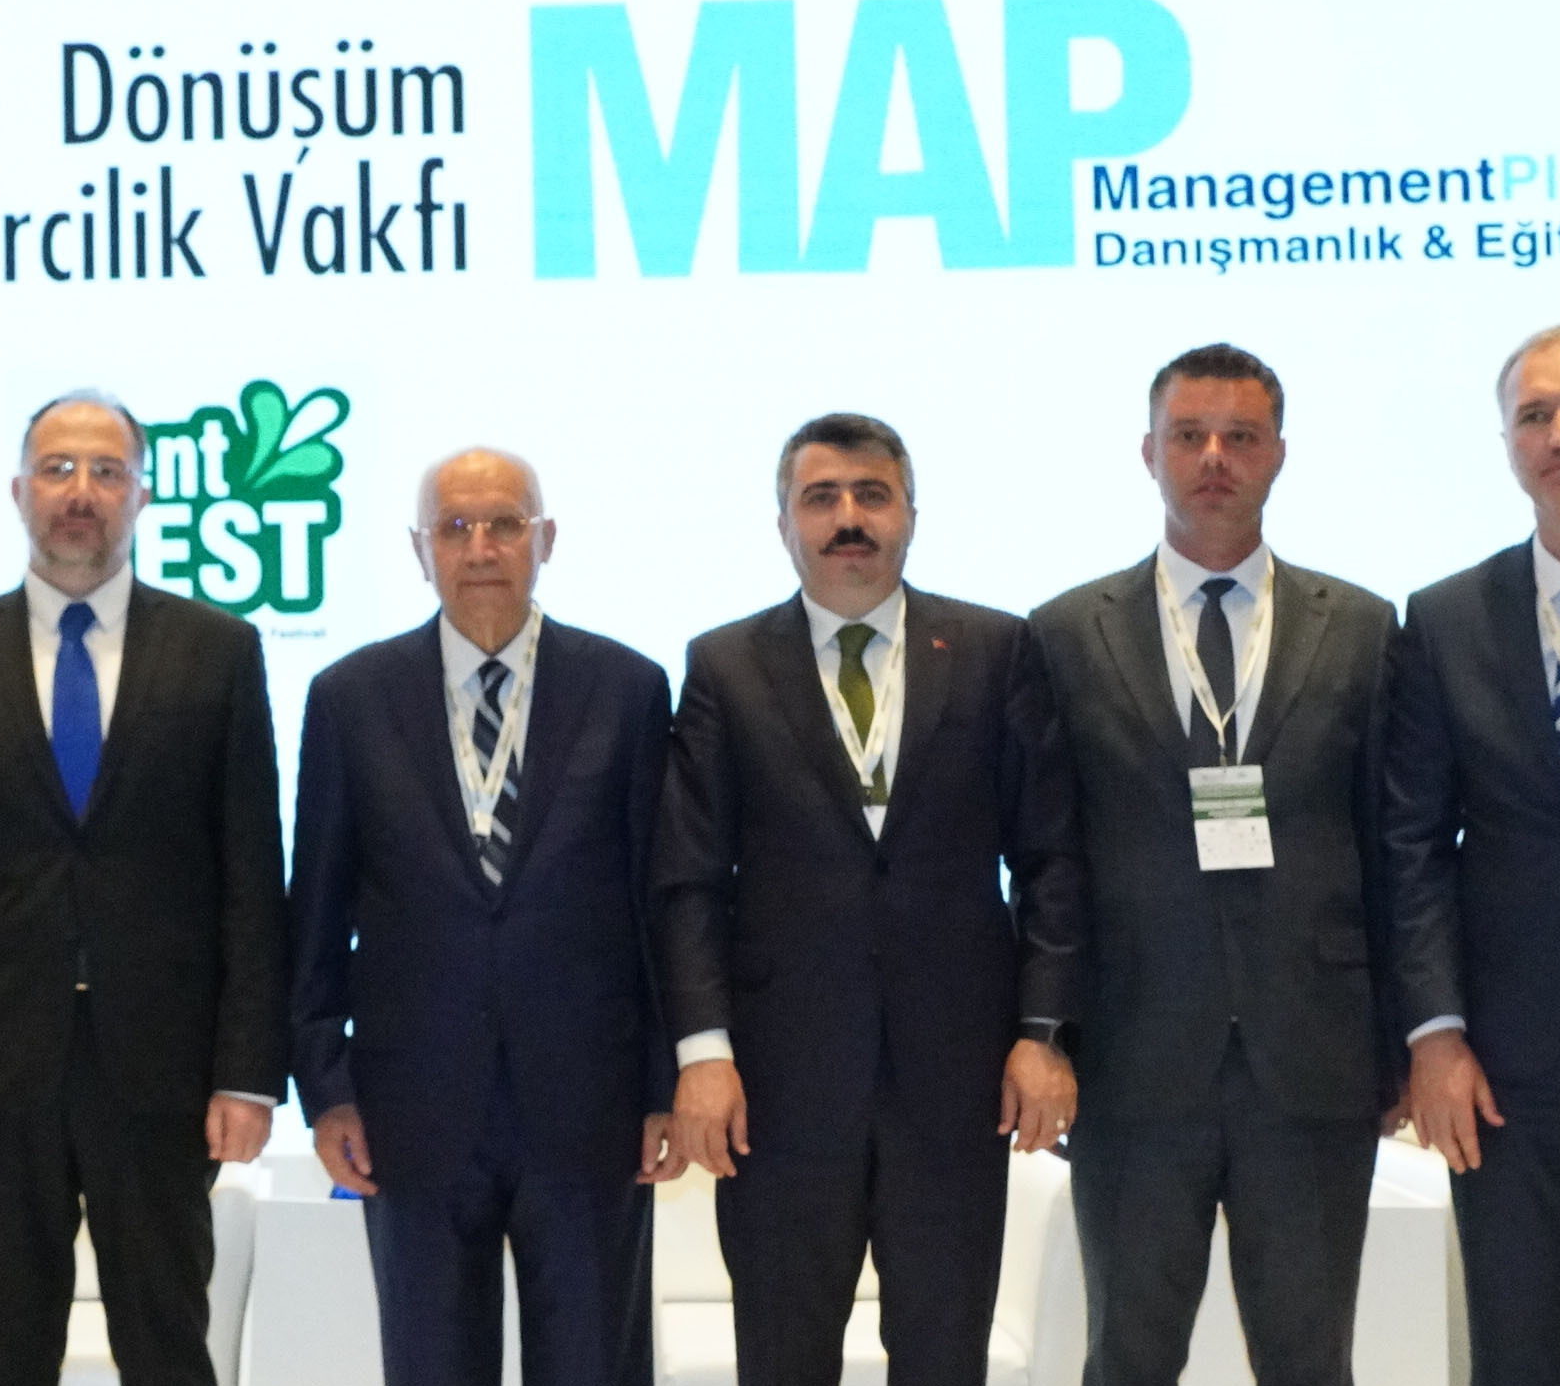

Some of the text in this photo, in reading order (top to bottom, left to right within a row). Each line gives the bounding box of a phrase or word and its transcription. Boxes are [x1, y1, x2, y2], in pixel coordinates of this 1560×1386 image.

[62, 39, 466, 165] Dönüşüm
[242, 158, 468, 276] Vakfı
[1093, 225, 1403, 277] Danışmanlık
[1422, 226, 1456, 261] &
[135, 498, 328, 604] EST
